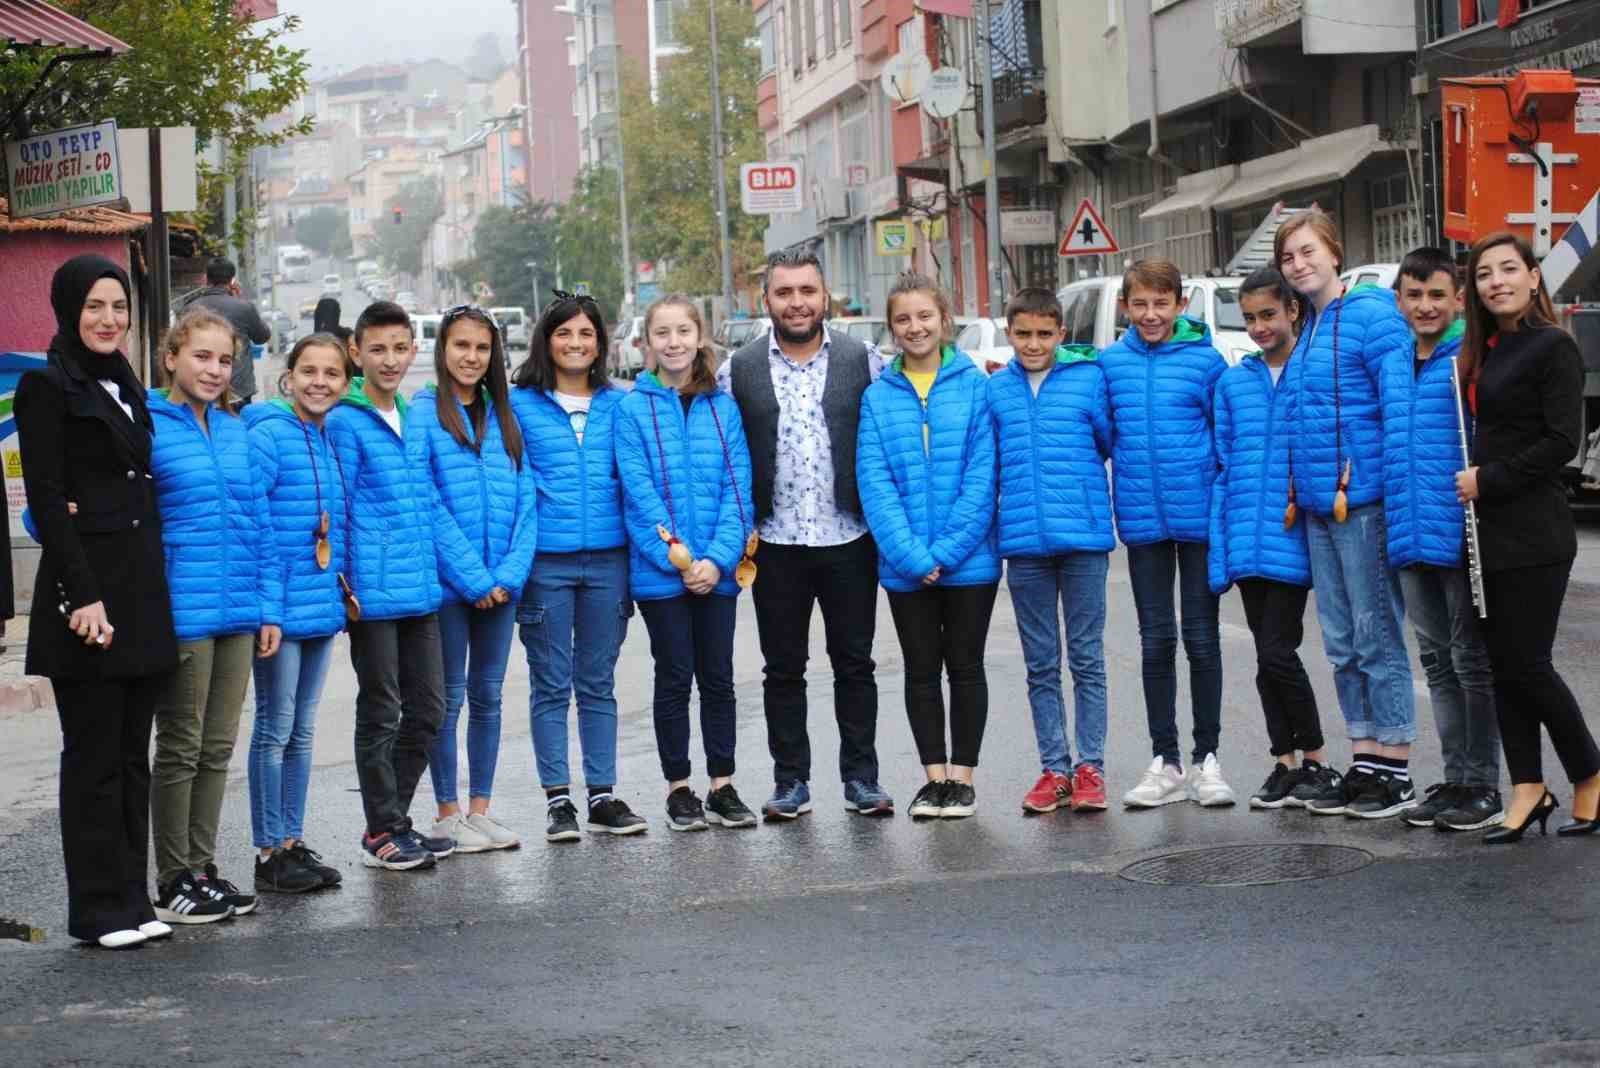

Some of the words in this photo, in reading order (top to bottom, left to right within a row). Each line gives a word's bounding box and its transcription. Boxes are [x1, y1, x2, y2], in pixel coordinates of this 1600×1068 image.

[20, 140, 52, 163] OTO
[58, 130, 101, 156] TEYP
[95, 152, 111, 172] CD
[63, 173, 113, 199] YAPILIR
